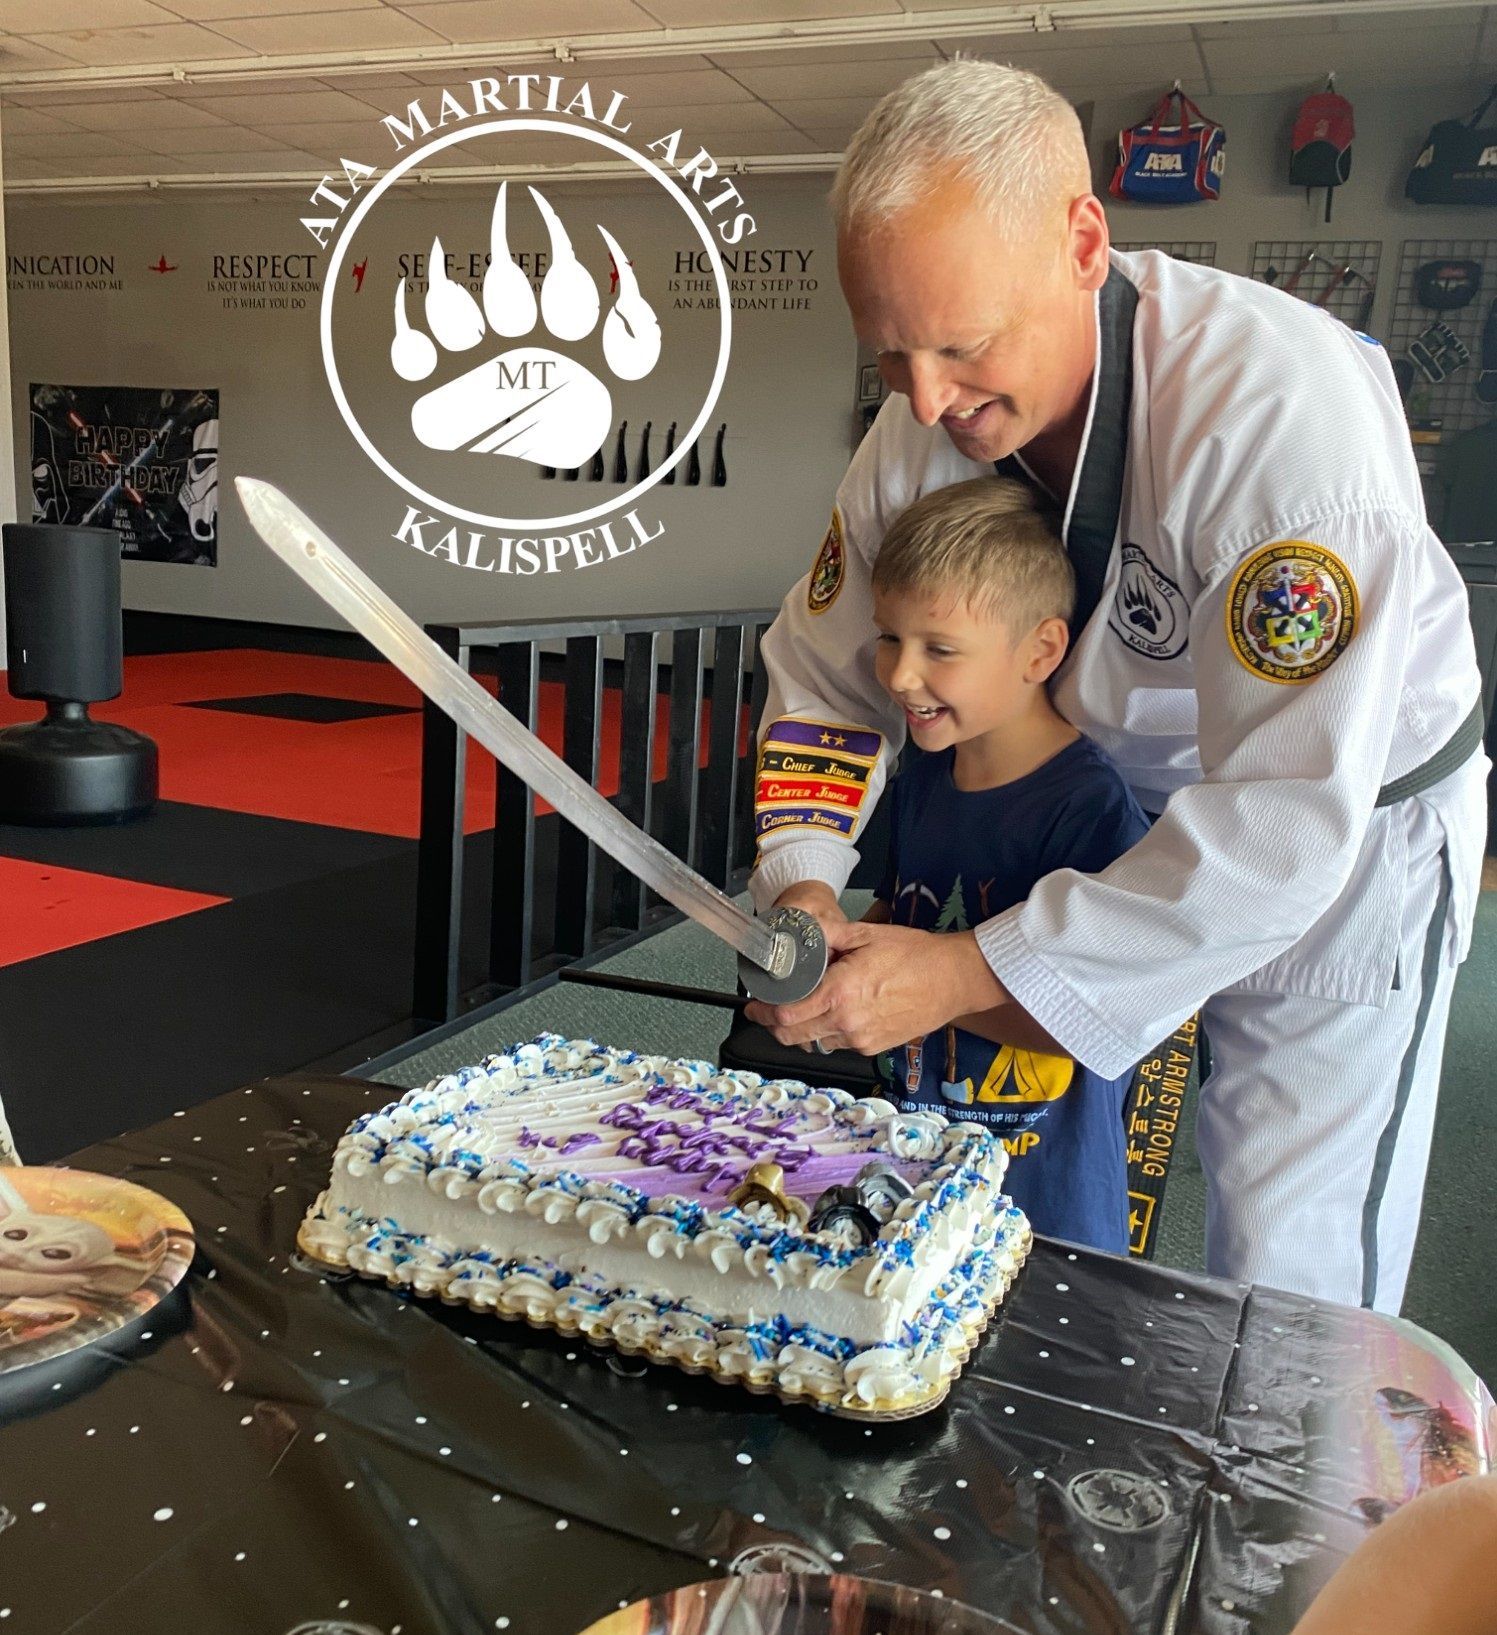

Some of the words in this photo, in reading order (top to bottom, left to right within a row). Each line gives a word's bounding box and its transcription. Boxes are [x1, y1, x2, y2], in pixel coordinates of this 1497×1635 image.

[213, 254, 317, 279] RESPECT
[674, 249, 815, 273] HONESTY
[28, 280, 44, 291] THE
[48, 280, 82, 291] WORLD
[84, 280, 107, 292] AND
[109, 280, 123, 291] ME
[207, 281, 215, 292] IS
[218, 281, 238, 292] NOT
[240, 281, 266, 292] WHAT
[269, 281, 288, 292] YOU
[291, 281, 321, 292] KNOW
[668, 279, 680, 291] IS
[685, 279, 712, 291] THE
[761, 279, 794, 291] STEP
[798, 278, 818, 291] TO
[240, 298, 266, 309] WHAT
[269, 298, 288, 309] YOU
[291, 298, 306, 309] DO
[673, 298, 693, 310] AN
[783, 298, 811, 310] LIFE
[75, 425, 171, 459] HAPPY
[68, 460, 180, 495] BIRTHDAY
[782, 756, 816, 772] CHIEF
[824, 762, 857, 780] JUDGE
[767, 783, 811, 798] CENTER
[815, 785, 849, 802] JUDGE
[761, 813, 803, 830] CORNER
[807, 811, 841, 829] JUDGE
[900, 1100, 917, 1112] AND
[918, 1102, 928, 1111] IN
[930, 1104, 947, 1115] THE
[990, 1113, 1004, 1123] OF
[1004, 1113, 1019, 1123] HIS
[1141, 1049, 1191, 1177] ARMSTRONG
